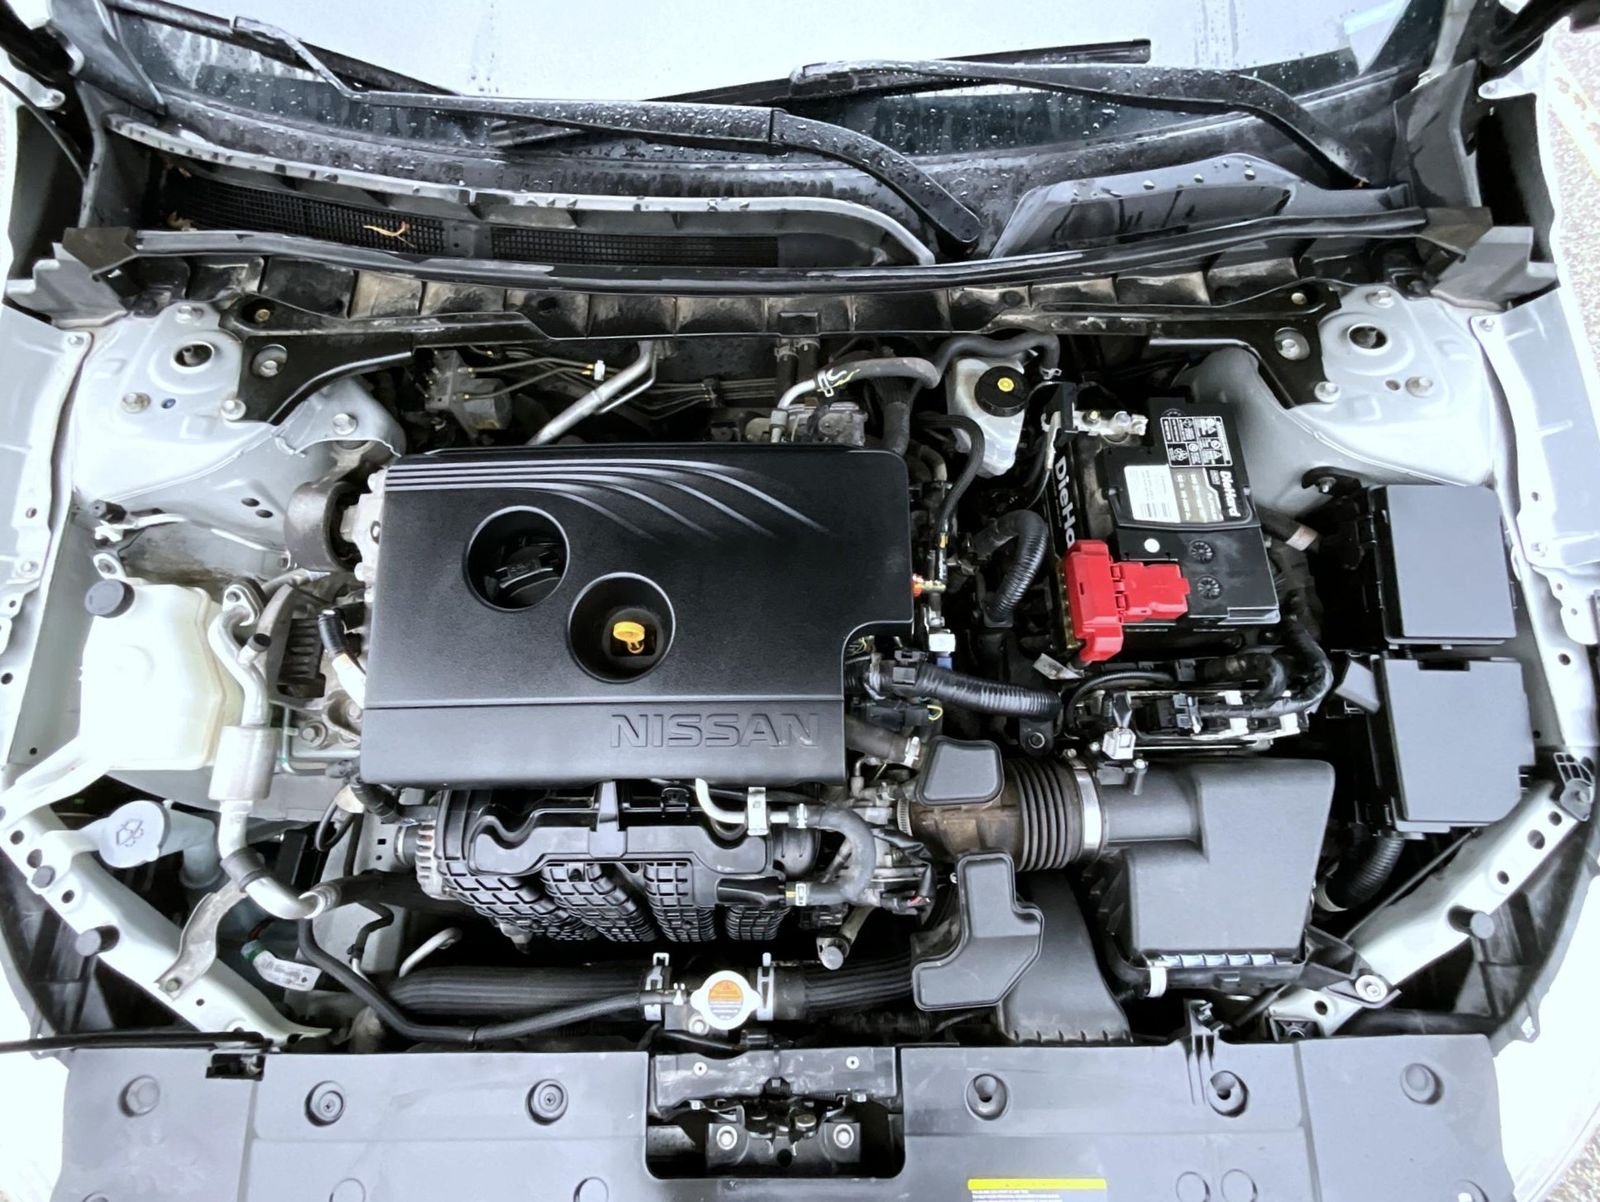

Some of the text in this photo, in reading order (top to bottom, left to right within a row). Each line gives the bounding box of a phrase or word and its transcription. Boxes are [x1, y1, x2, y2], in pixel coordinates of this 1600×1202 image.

[1055, 455, 1076, 550] DieHa
[1220, 470, 1241, 518] DieHard
[611, 713, 819, 748] NISSAN
